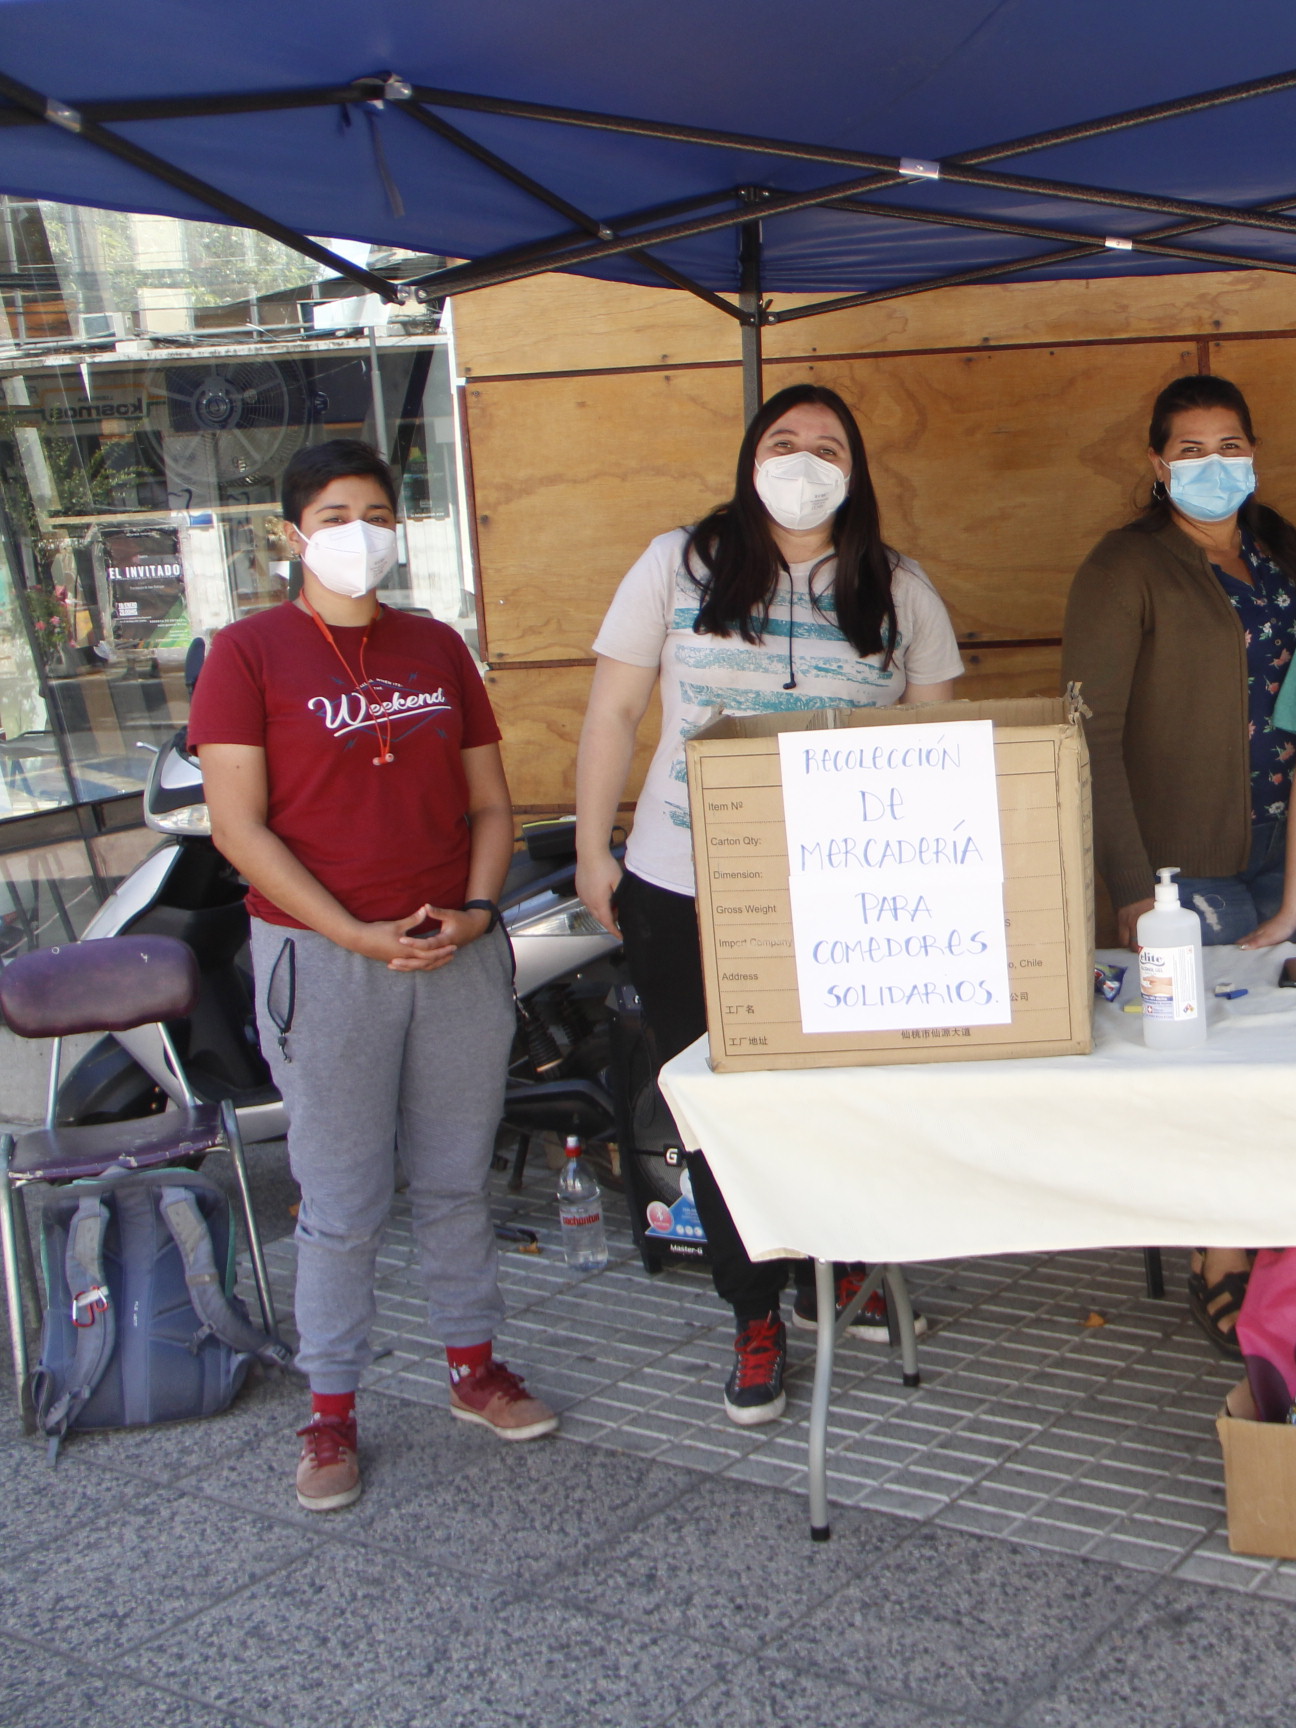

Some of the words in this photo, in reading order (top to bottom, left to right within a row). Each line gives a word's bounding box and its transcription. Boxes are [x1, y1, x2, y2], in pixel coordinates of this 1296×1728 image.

[108, 567, 122, 579] EL
[126, 564, 181, 578] INVITADO
[308, 687, 446, 729] Weekend
[803, 734, 961, 775] RECOLECCIÓN
[708, 802, 729, 812] Item
[859, 787, 904, 822] DE
[710, 836, 741, 846] Carton
[743, 836, 762, 847] Qty:
[801, 819, 983, 871] MERCADERÍA
[713, 870, 763, 880] Dimension:
[716, 905, 743, 914] Gross
[745, 904, 777, 915] Weight
[854, 892, 932, 924] PARA
[719, 938, 747, 949] Import
[813, 929, 988, 965] COMEDORES
[1019, 959, 1043, 968] Chile
[722, 972, 759, 981] Address
[725, 1004, 755, 1015] 工厂名
[729, 1035, 769, 1047] 工厂地址
[666, 1147, 678, 1165] G
[670, 1243, 703, 1255] Master-G
